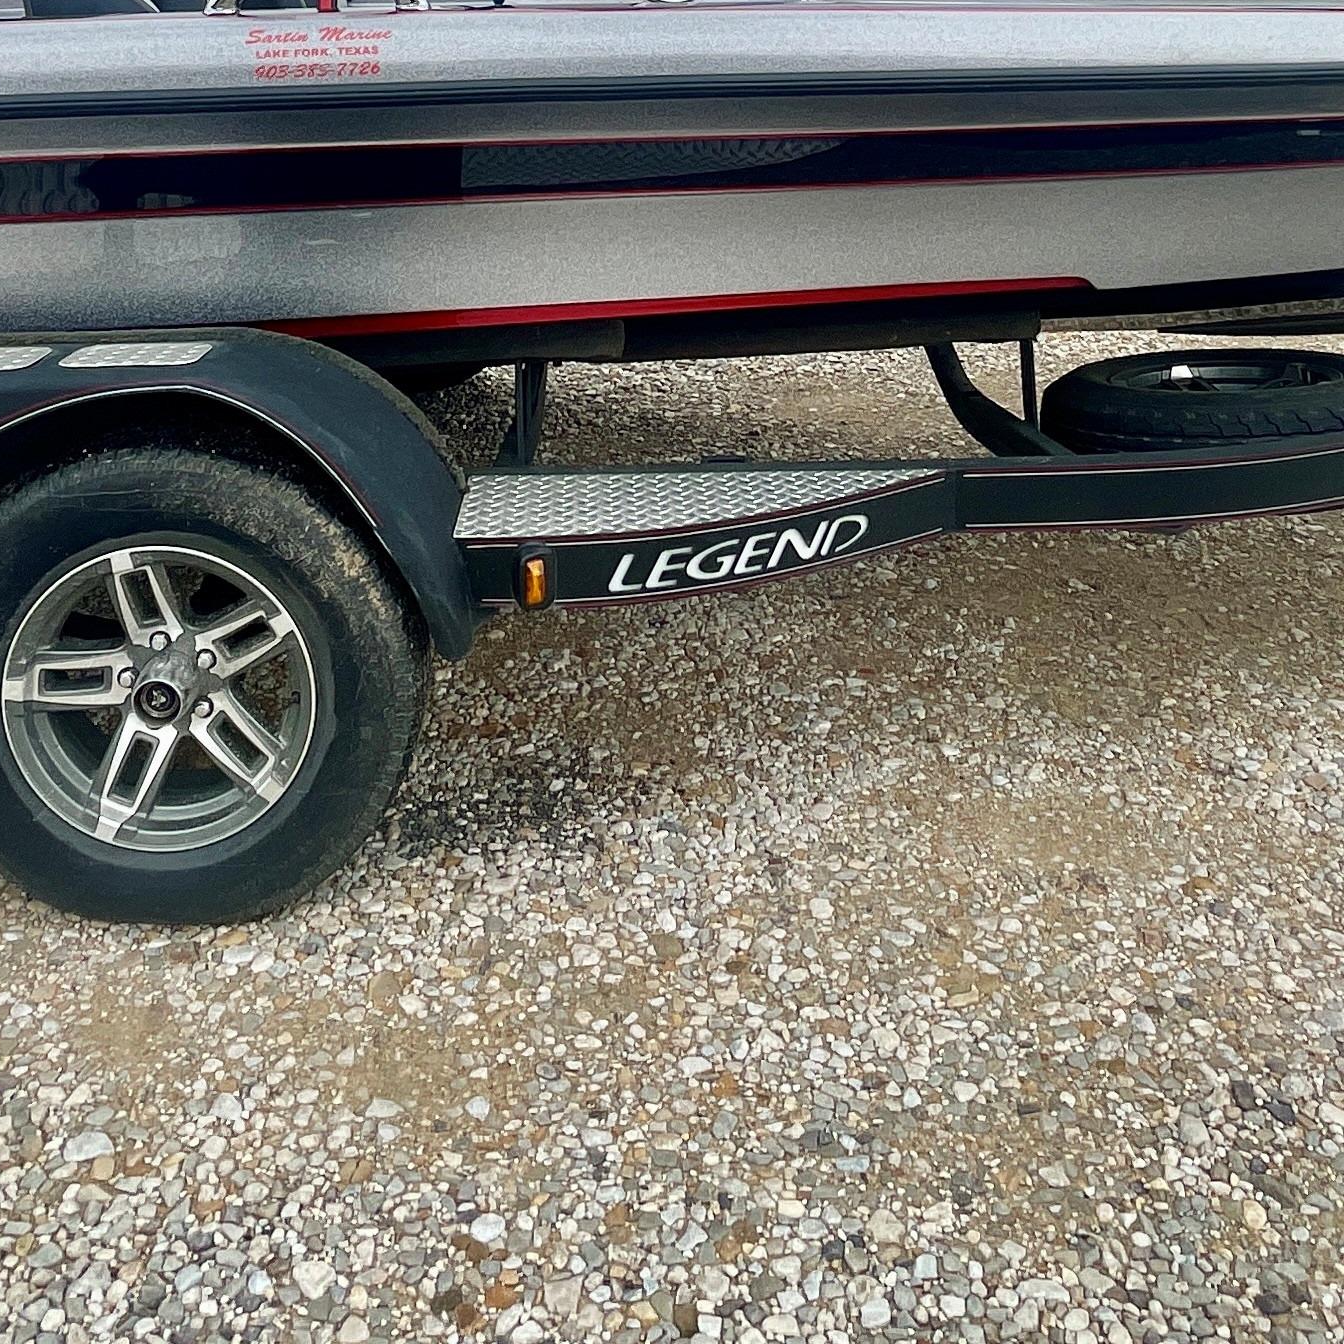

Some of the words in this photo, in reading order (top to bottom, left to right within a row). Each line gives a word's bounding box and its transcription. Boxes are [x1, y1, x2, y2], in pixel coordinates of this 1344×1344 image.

[245, 28, 309, 44] Sartin
[318, 25, 393, 42] Marine
[256, 49, 289, 59] LAKE
[337, 46, 379, 56] TEXAS
[608, 514, 870, 593] LEGEND
